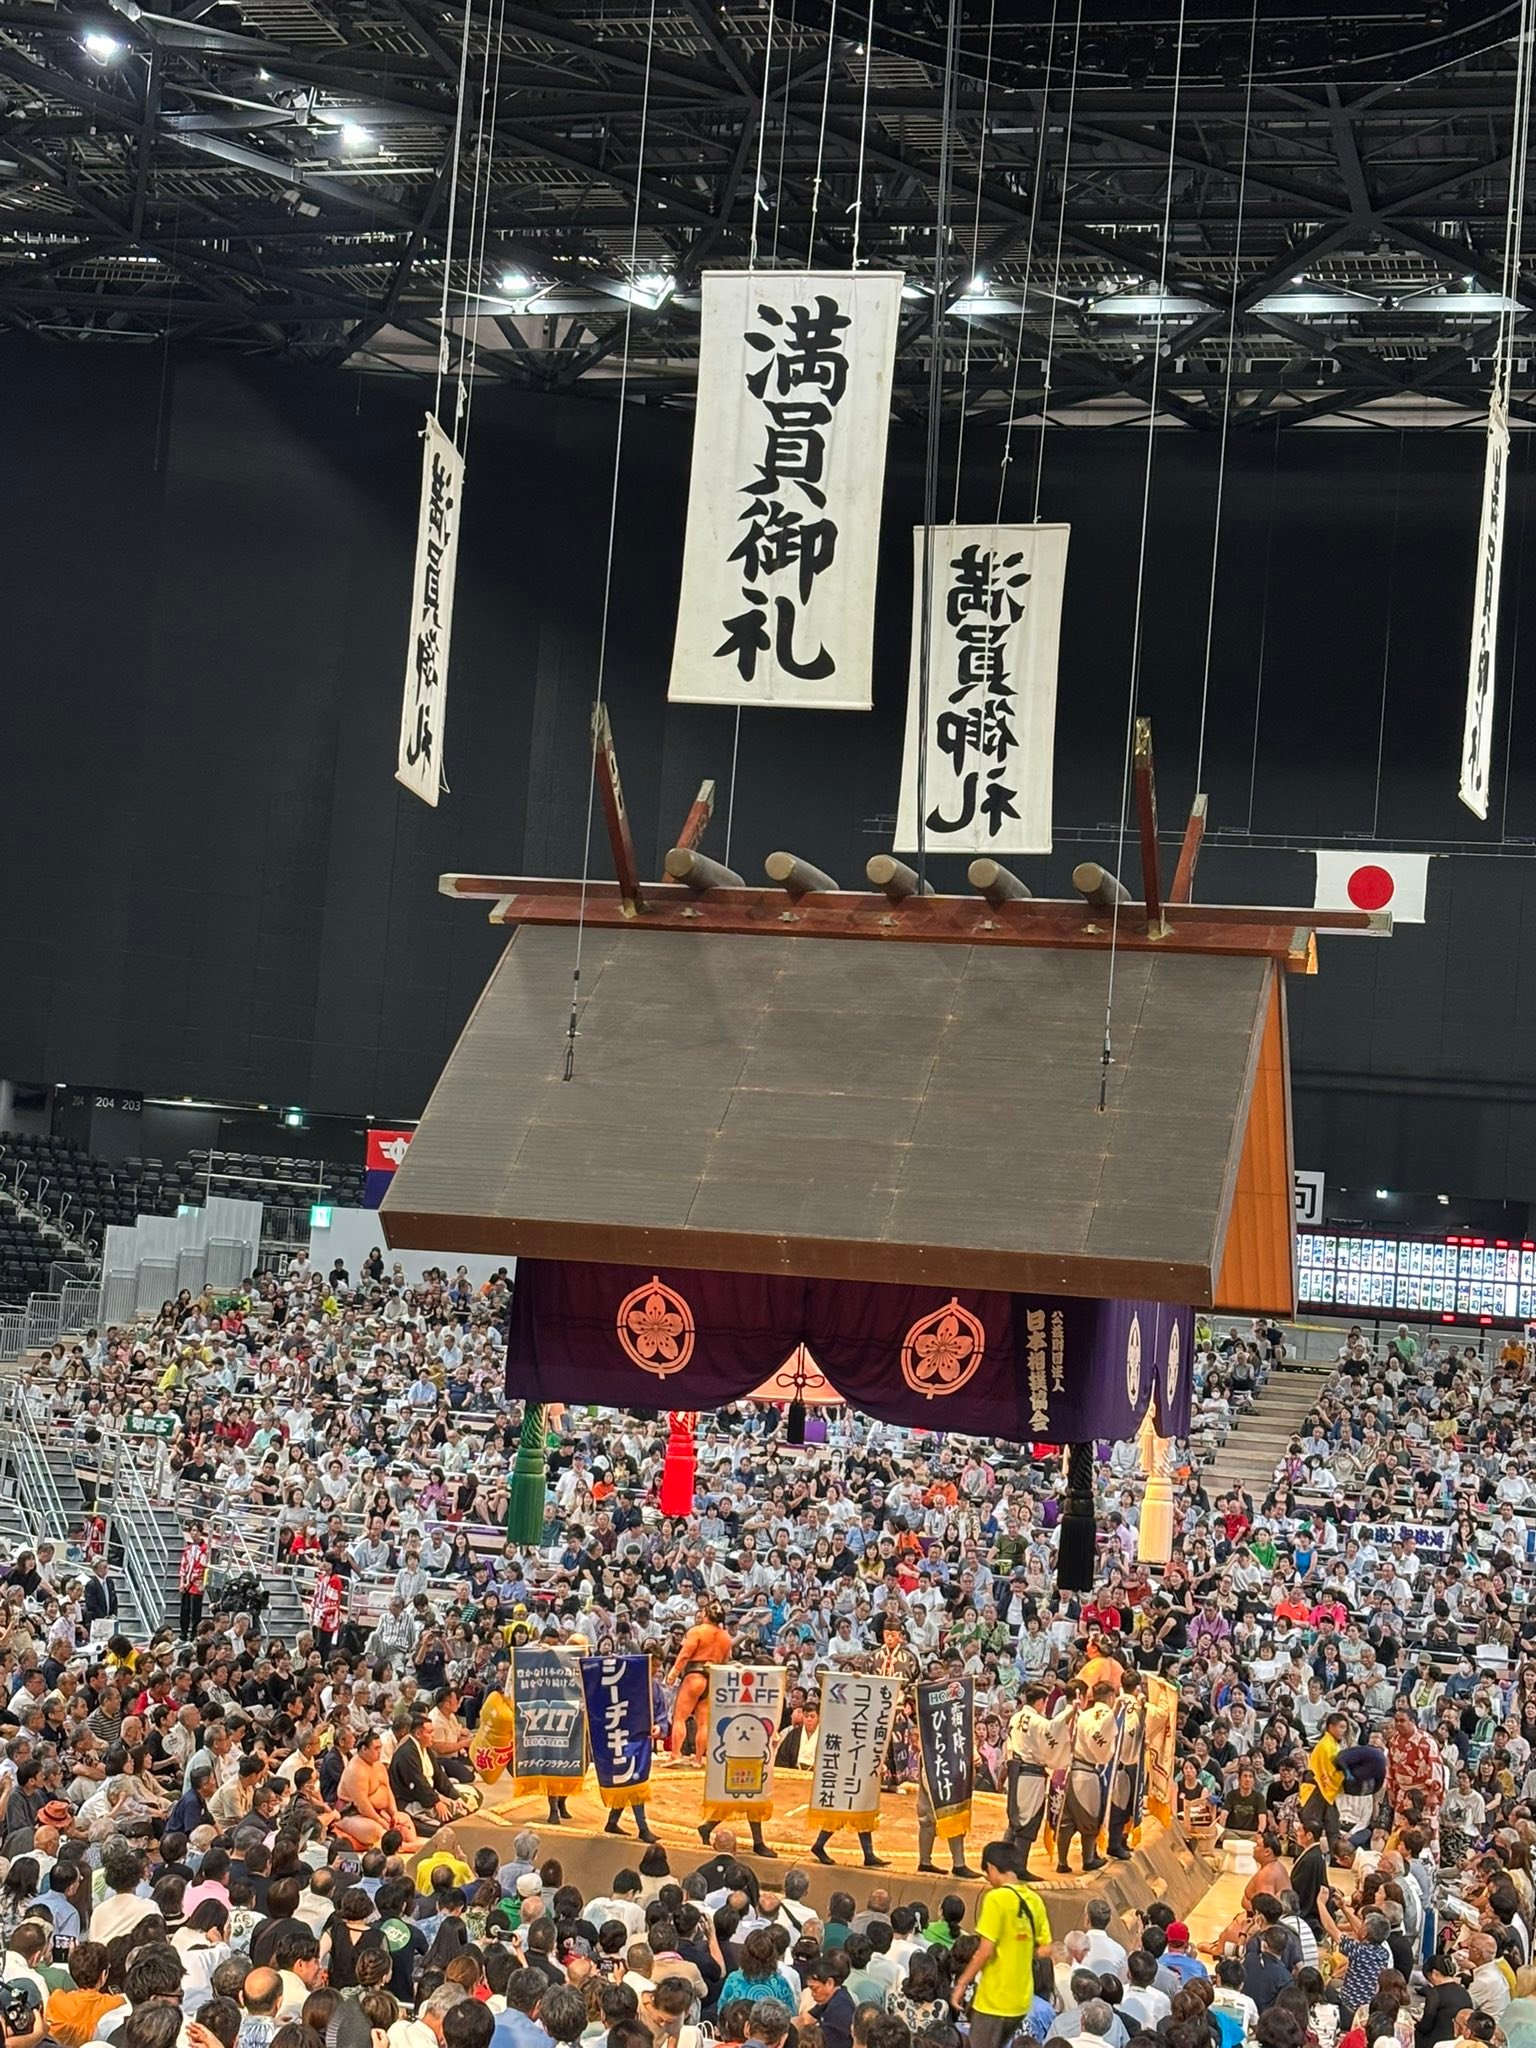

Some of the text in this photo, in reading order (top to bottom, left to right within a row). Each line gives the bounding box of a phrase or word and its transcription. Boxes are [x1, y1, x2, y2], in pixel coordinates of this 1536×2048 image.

[713, 295, 852, 682] 満員御礼
[95, 1096, 115, 1108] 204
[122, 1100, 141, 1111] 203
[1025, 1308, 1050, 1432] 日本相撲協会
[715, 1688, 780, 1704] STAFF
[727, 1671, 769, 1686] HOT
[524, 1708, 577, 1732] YIT
[601, 1658, 636, 1784] シーチキン
[870, 1685, 893, 1778] もっと向こうへ
[931, 1709, 953, 1801] ひらたけ
[950, 1702, 967, 1781] 霜降り
[819, 1733, 842, 1808] 株式会社
